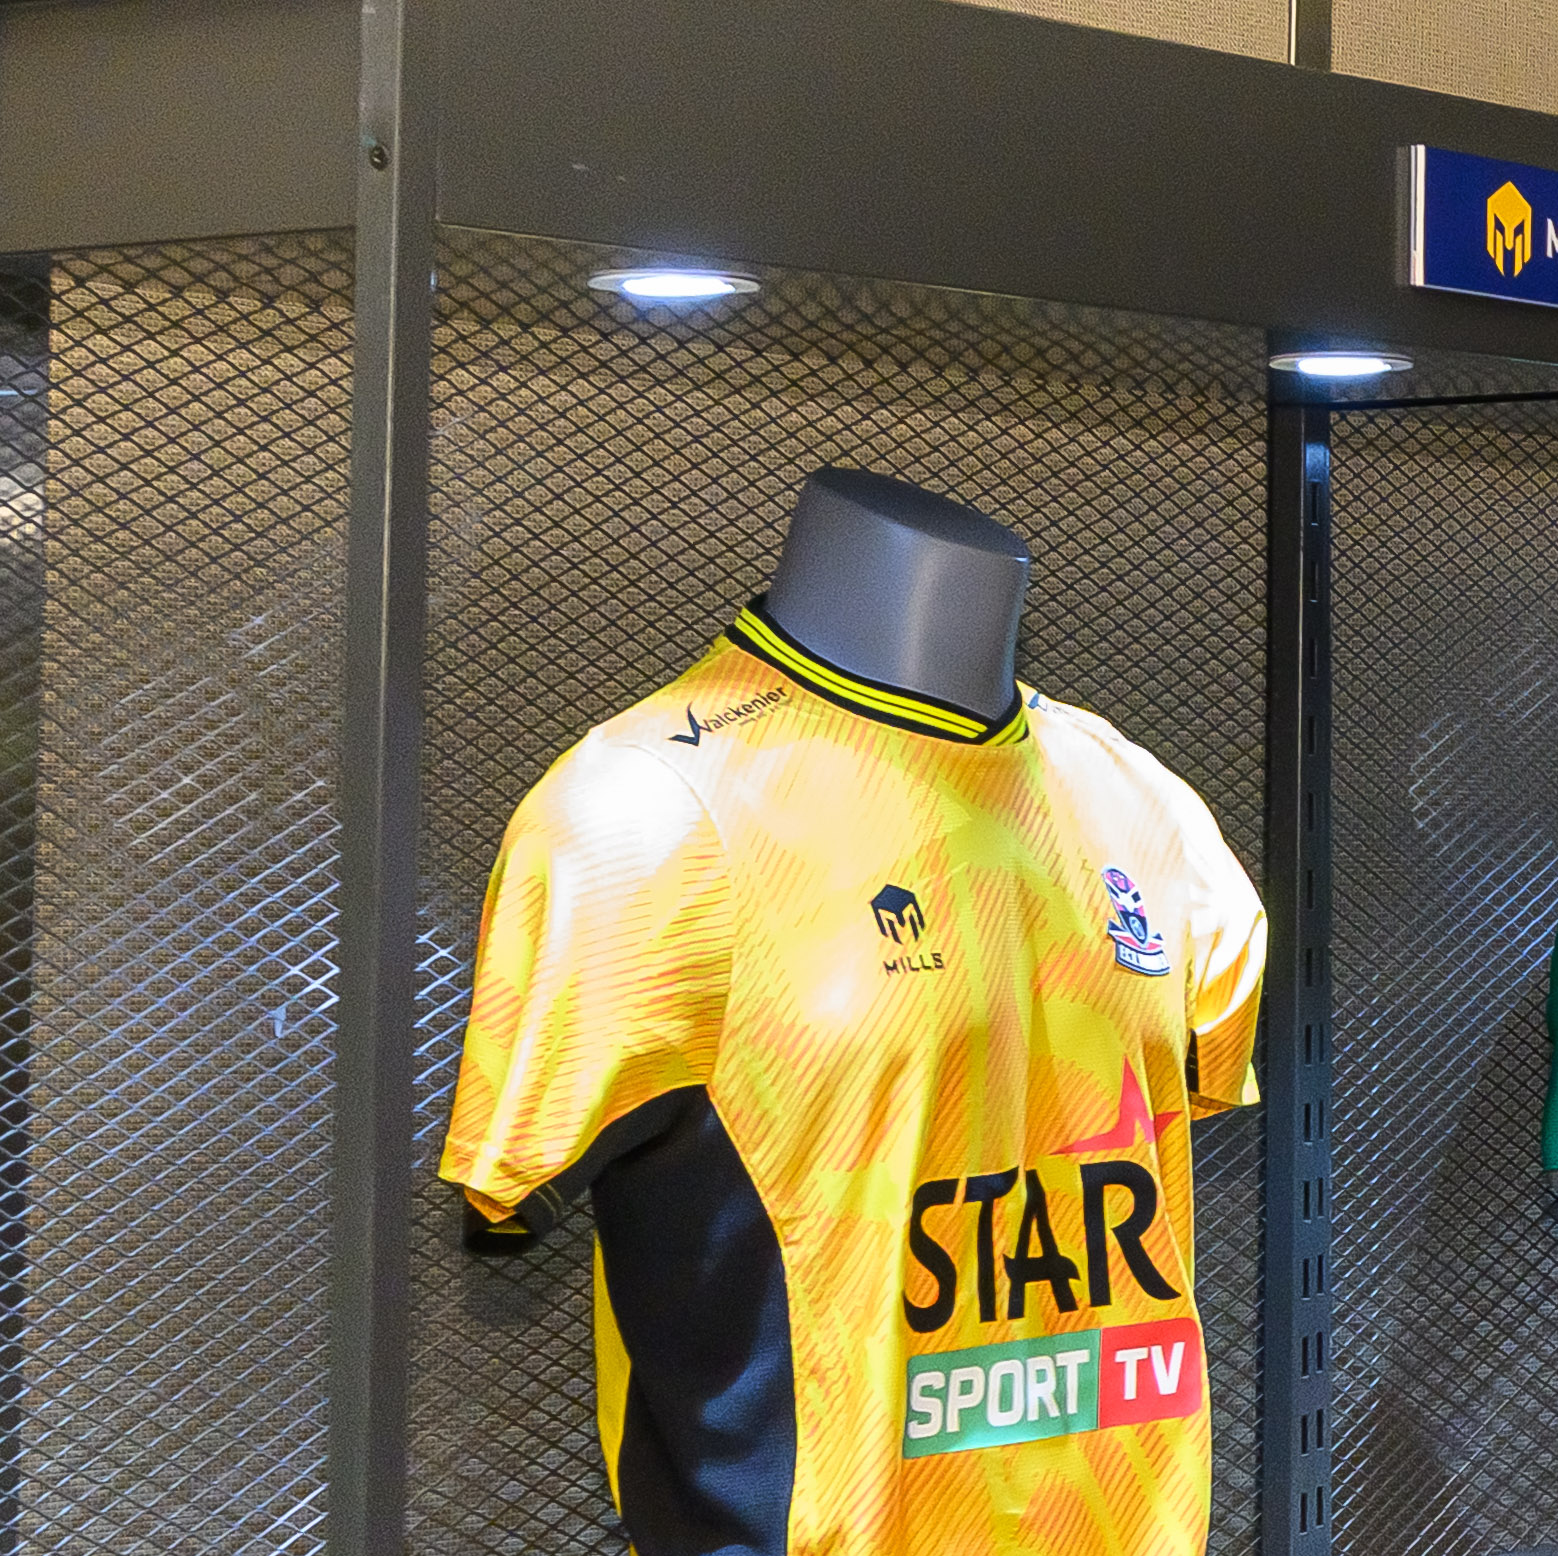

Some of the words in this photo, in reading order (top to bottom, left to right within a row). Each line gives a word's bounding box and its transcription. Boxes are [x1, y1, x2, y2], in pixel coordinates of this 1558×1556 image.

[883, 952, 945, 977] MILLS
[903, 1160, 1182, 1334] STAR
[907, 1349, 1090, 1439] SPORT
[1115, 1341, 1185, 1400] TV
